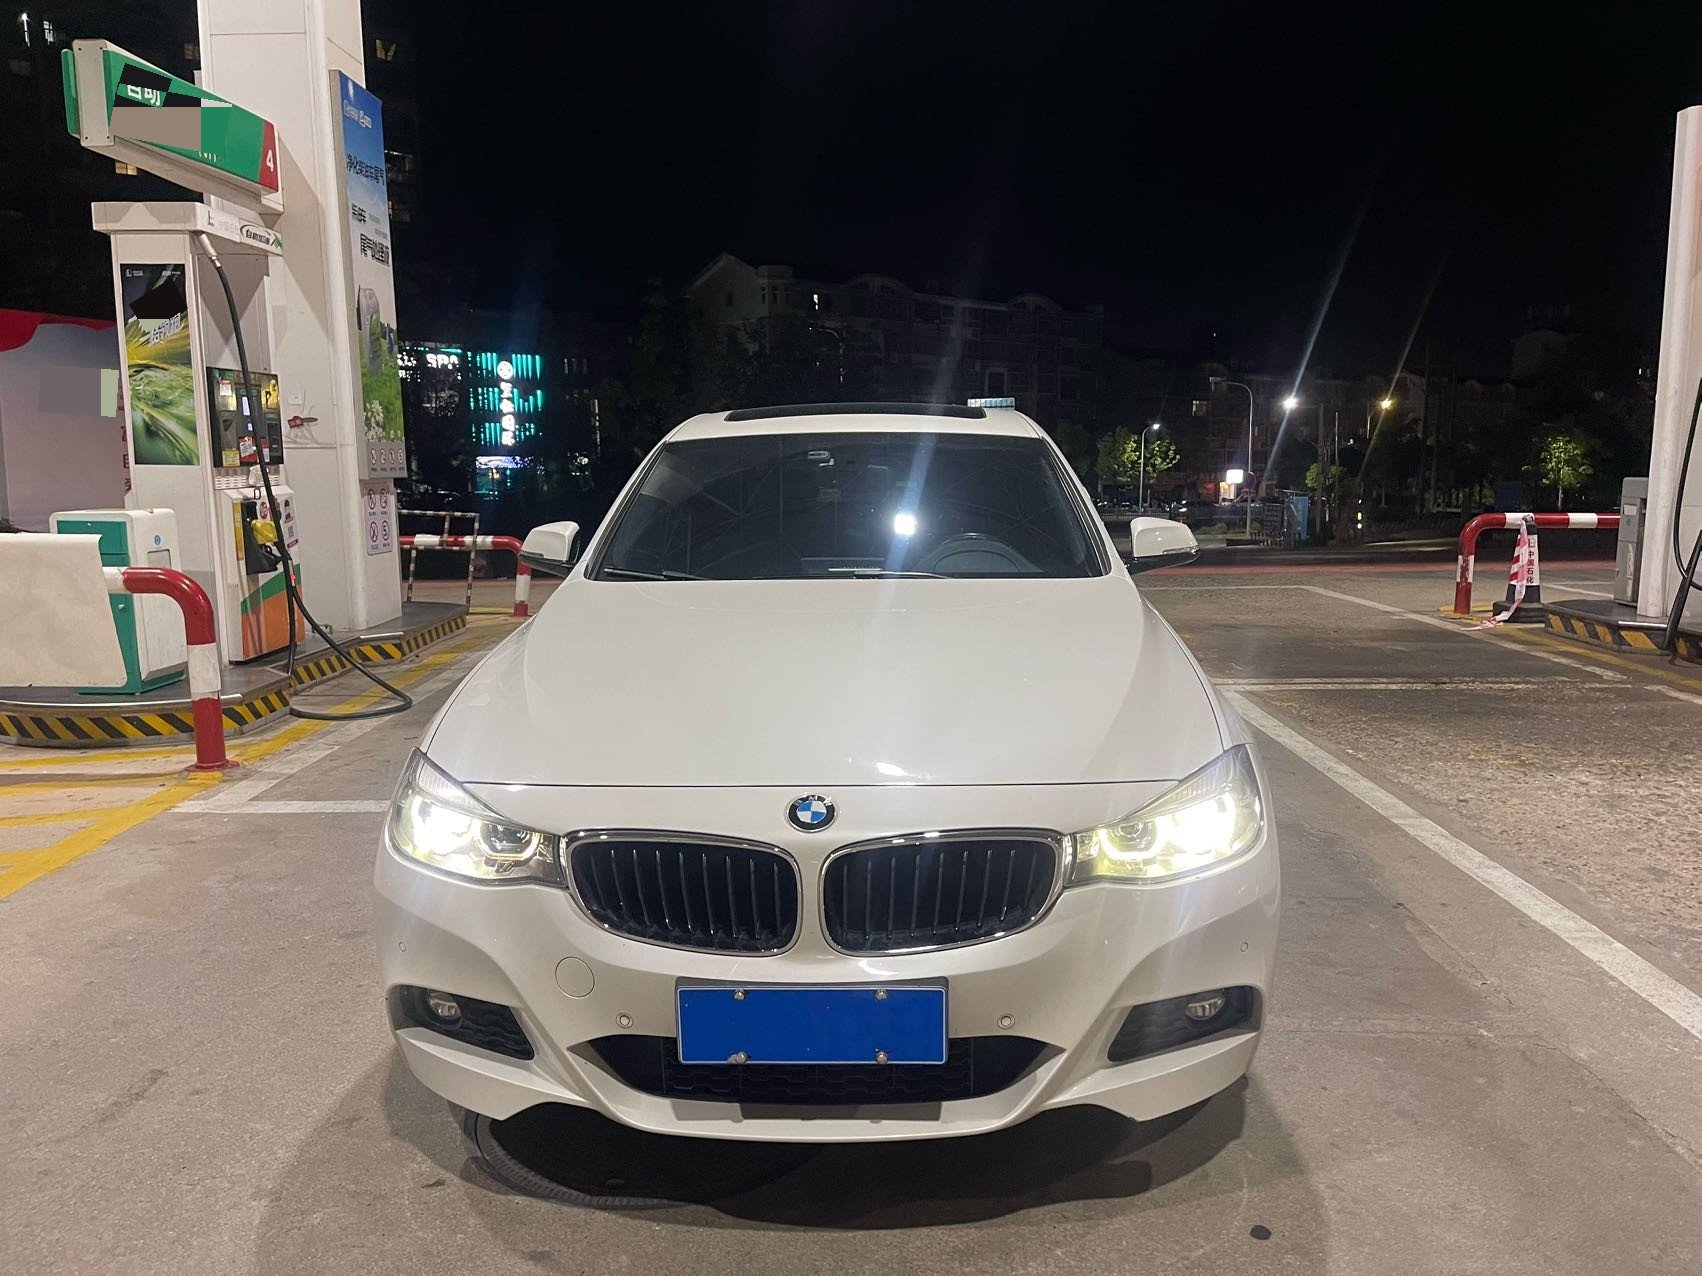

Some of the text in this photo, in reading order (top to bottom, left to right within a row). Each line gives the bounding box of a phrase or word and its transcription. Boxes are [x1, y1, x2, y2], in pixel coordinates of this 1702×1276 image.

[265, 149, 274, 172] 4
[1527, 550, 1535, 584] 中国石化
